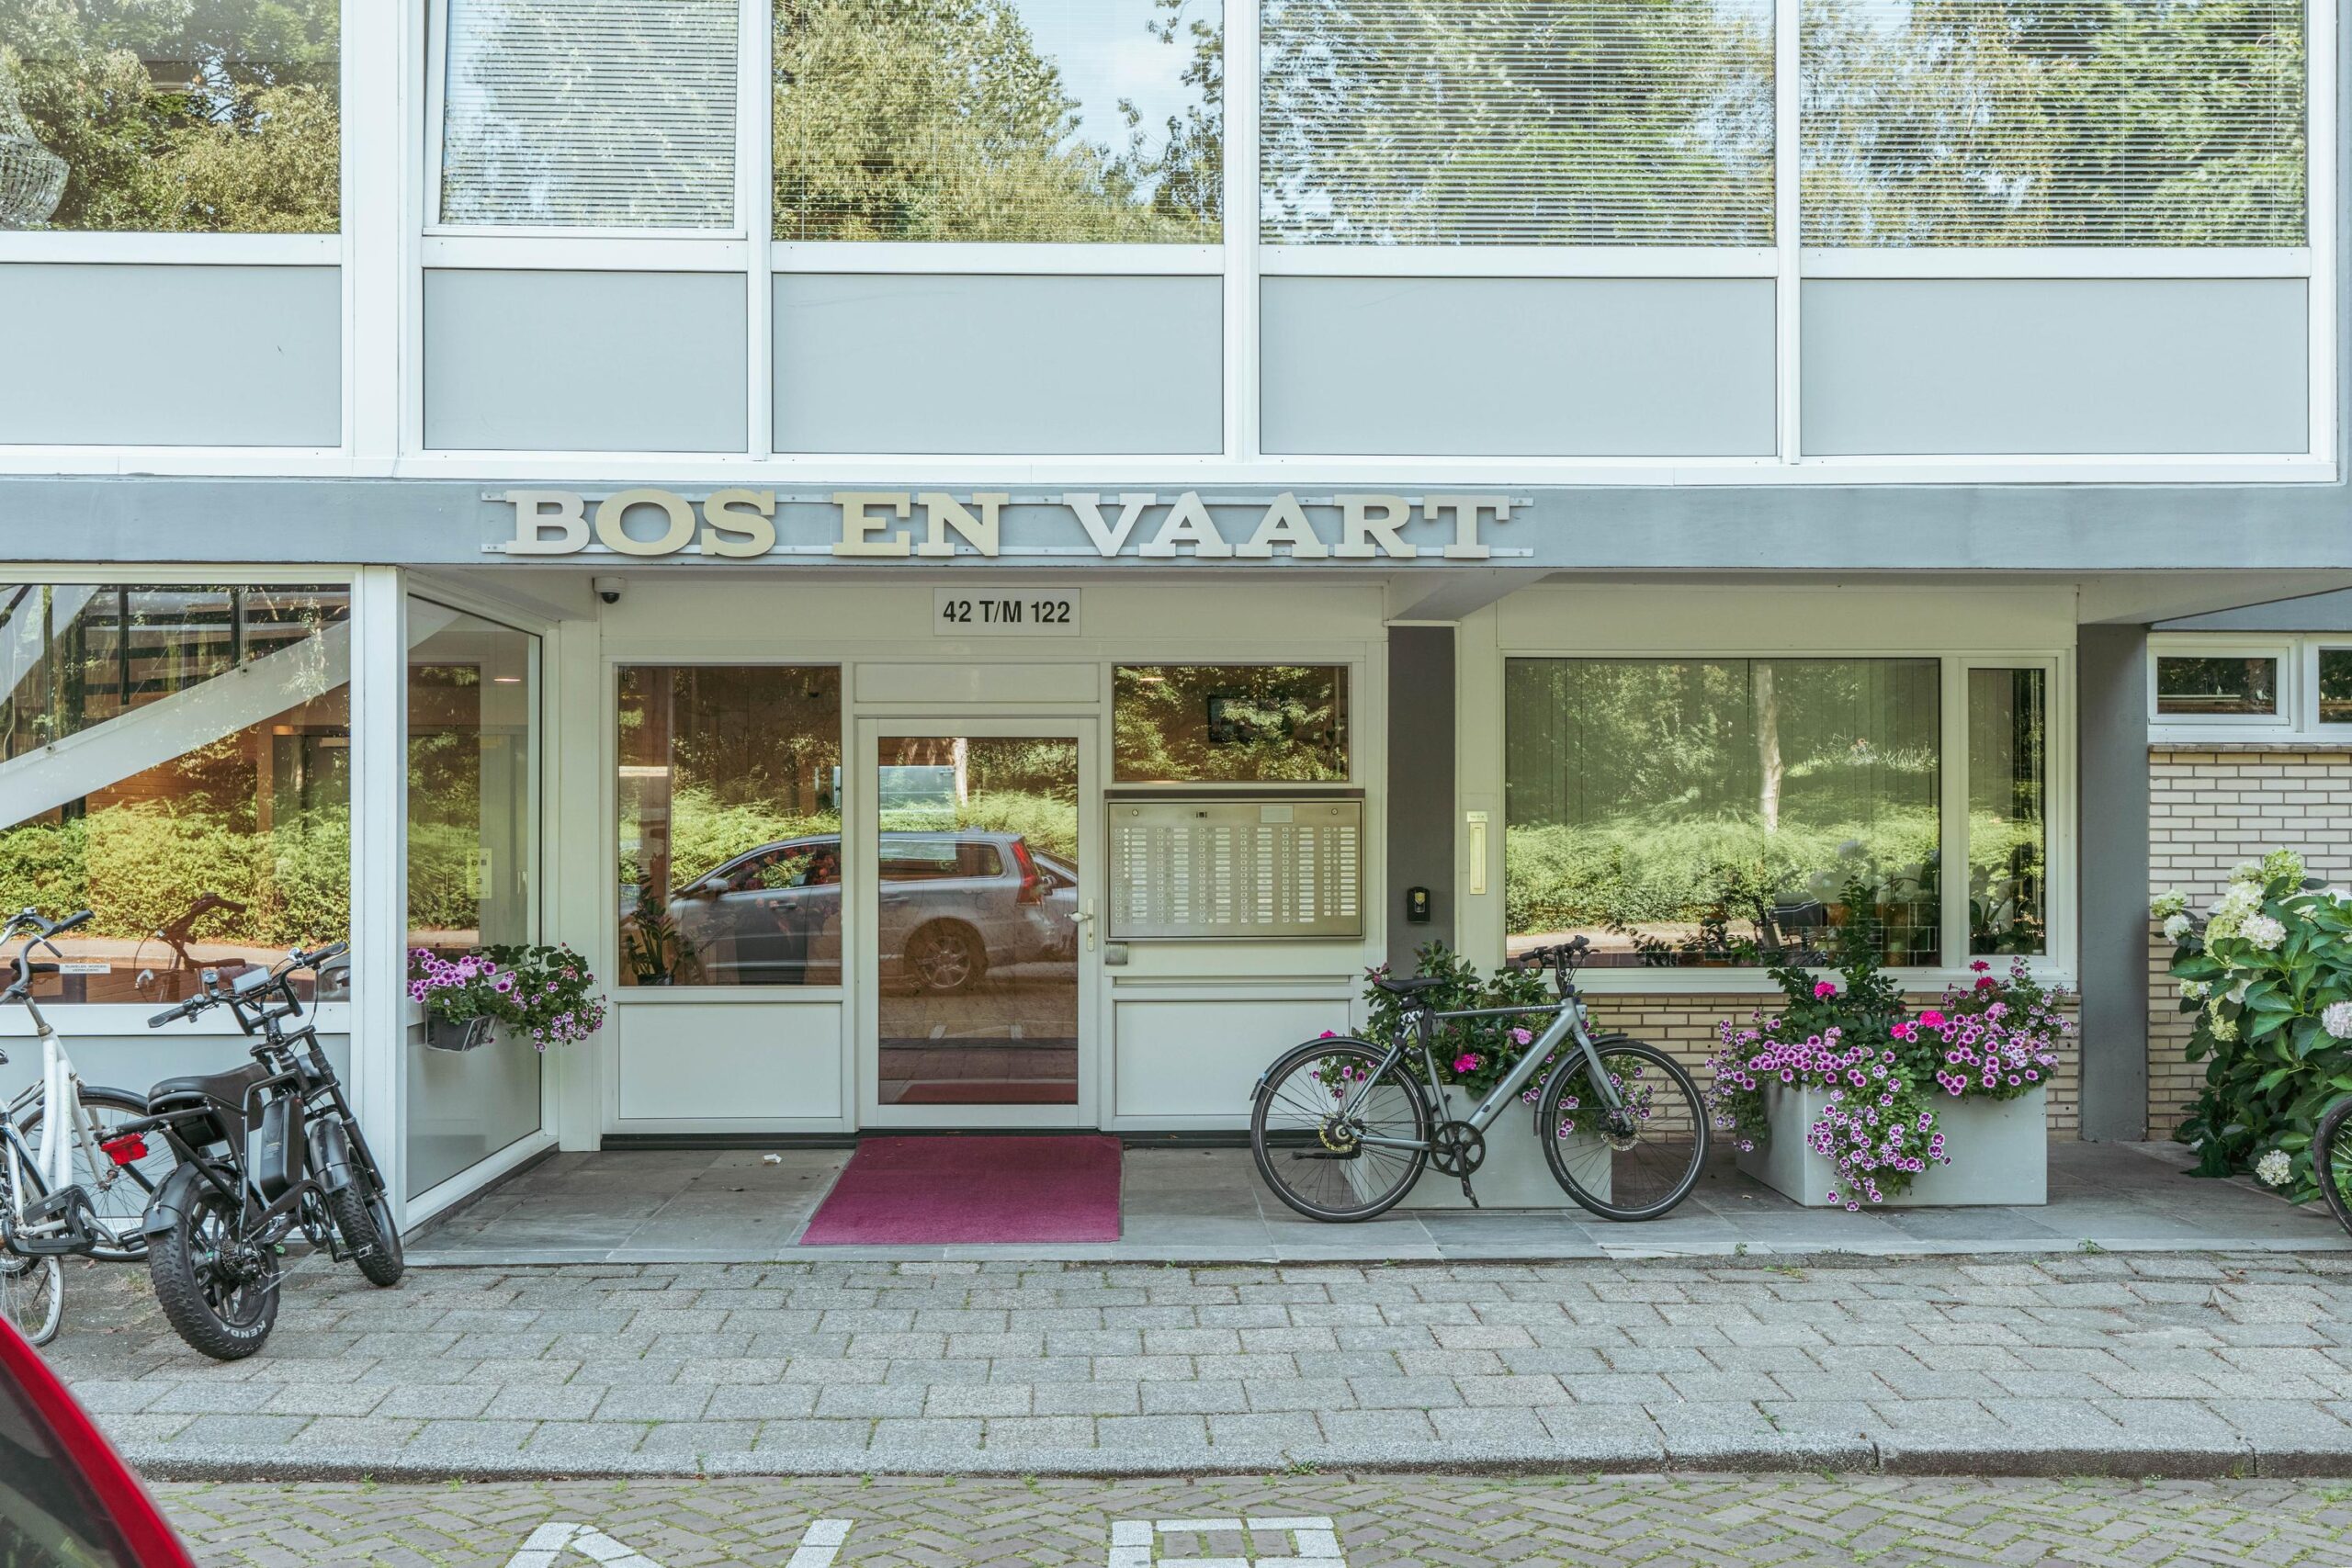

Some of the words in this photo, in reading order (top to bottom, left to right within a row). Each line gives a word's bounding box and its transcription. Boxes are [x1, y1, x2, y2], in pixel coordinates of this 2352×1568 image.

[505, 489, 775, 558] BOS
[832, 492, 1009, 557] EN
[1063, 491, 1510, 558] VAART
[943, 600, 972, 623] 42
[978, 600, 1022, 624] T/M
[1030, 600, 1070, 623] 122
[221, 1320, 266, 1338] KENDA
